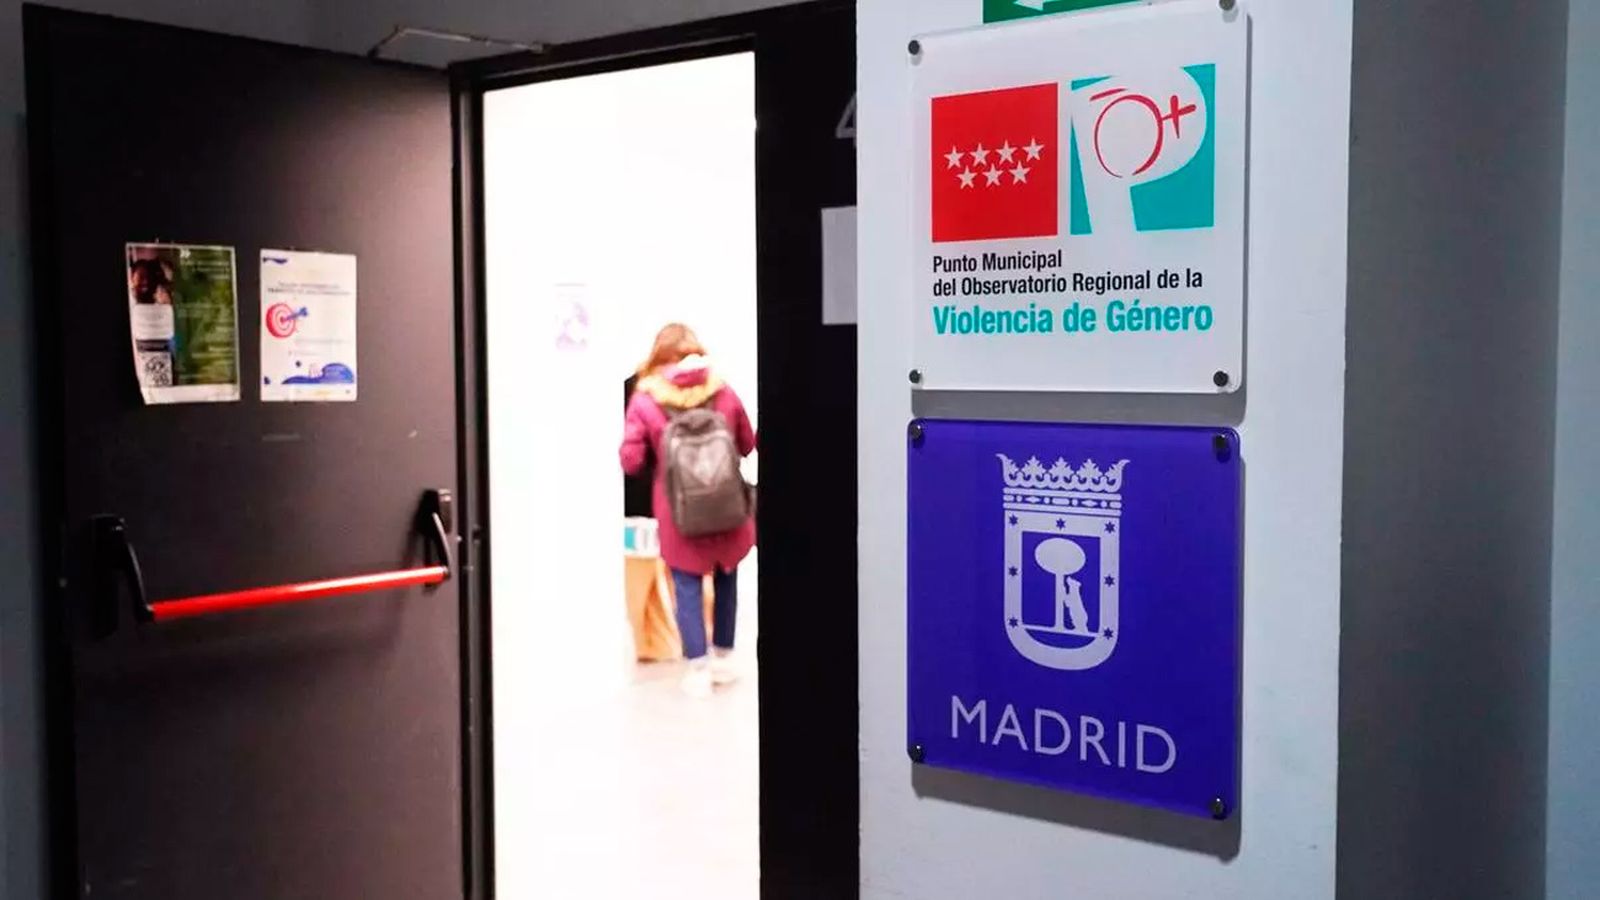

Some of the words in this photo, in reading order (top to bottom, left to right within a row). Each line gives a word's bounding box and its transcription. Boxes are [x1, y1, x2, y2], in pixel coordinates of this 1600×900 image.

[933, 254, 978, 273] Punto
[983, 250, 1062, 273] Municipal
[933, 278, 956, 297] del
[962, 275, 1067, 296] Observatorio
[1073, 270, 1150, 295] Regional
[1157, 270, 1180, 289] de
[1187, 268, 1203, 288] la
[933, 303, 1054, 335] Violencia
[1063, 301, 1099, 332] de
[1106, 299, 1214, 331] Género
[951, 695, 1177, 773] MADRID
